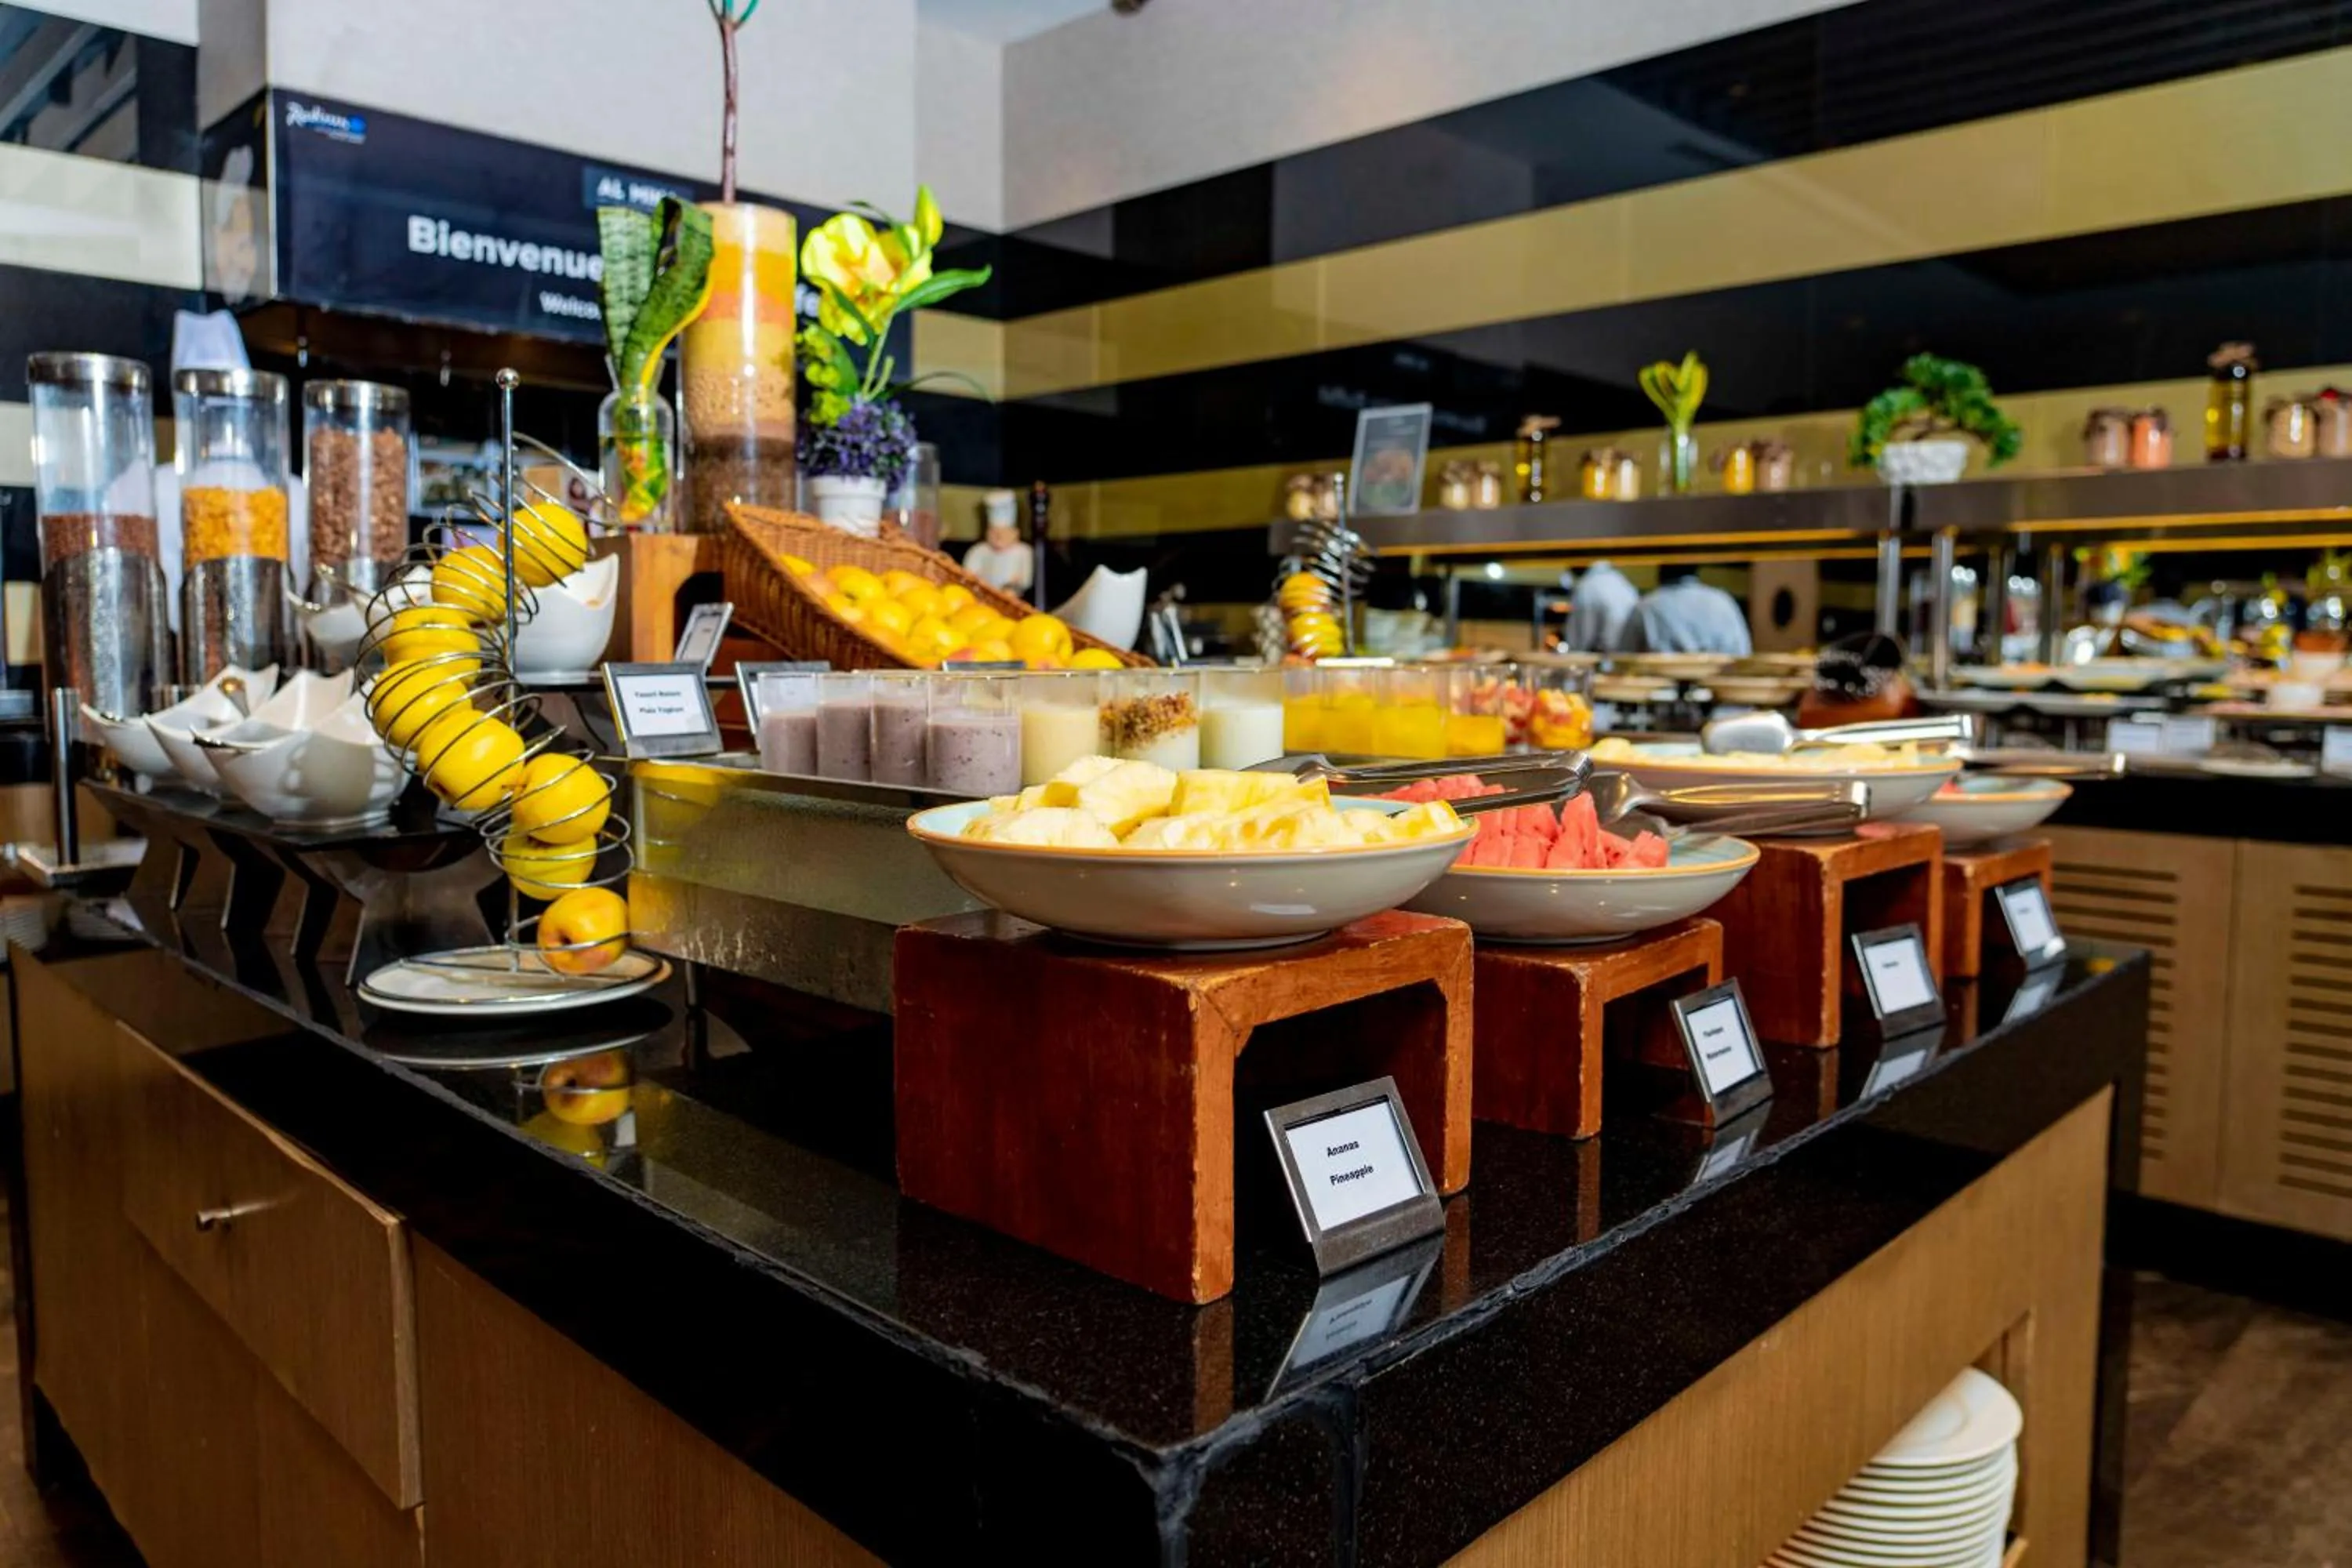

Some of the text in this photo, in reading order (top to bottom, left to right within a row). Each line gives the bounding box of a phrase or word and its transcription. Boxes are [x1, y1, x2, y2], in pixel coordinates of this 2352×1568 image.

[597, 176, 625, 199] AL
[407, 214, 604, 283] Bienvenue
[539, 291, 602, 321] Welco
[1327, 1141, 1360, 1158] Ananas
[1330, 1163, 1374, 1186] Pineapple
